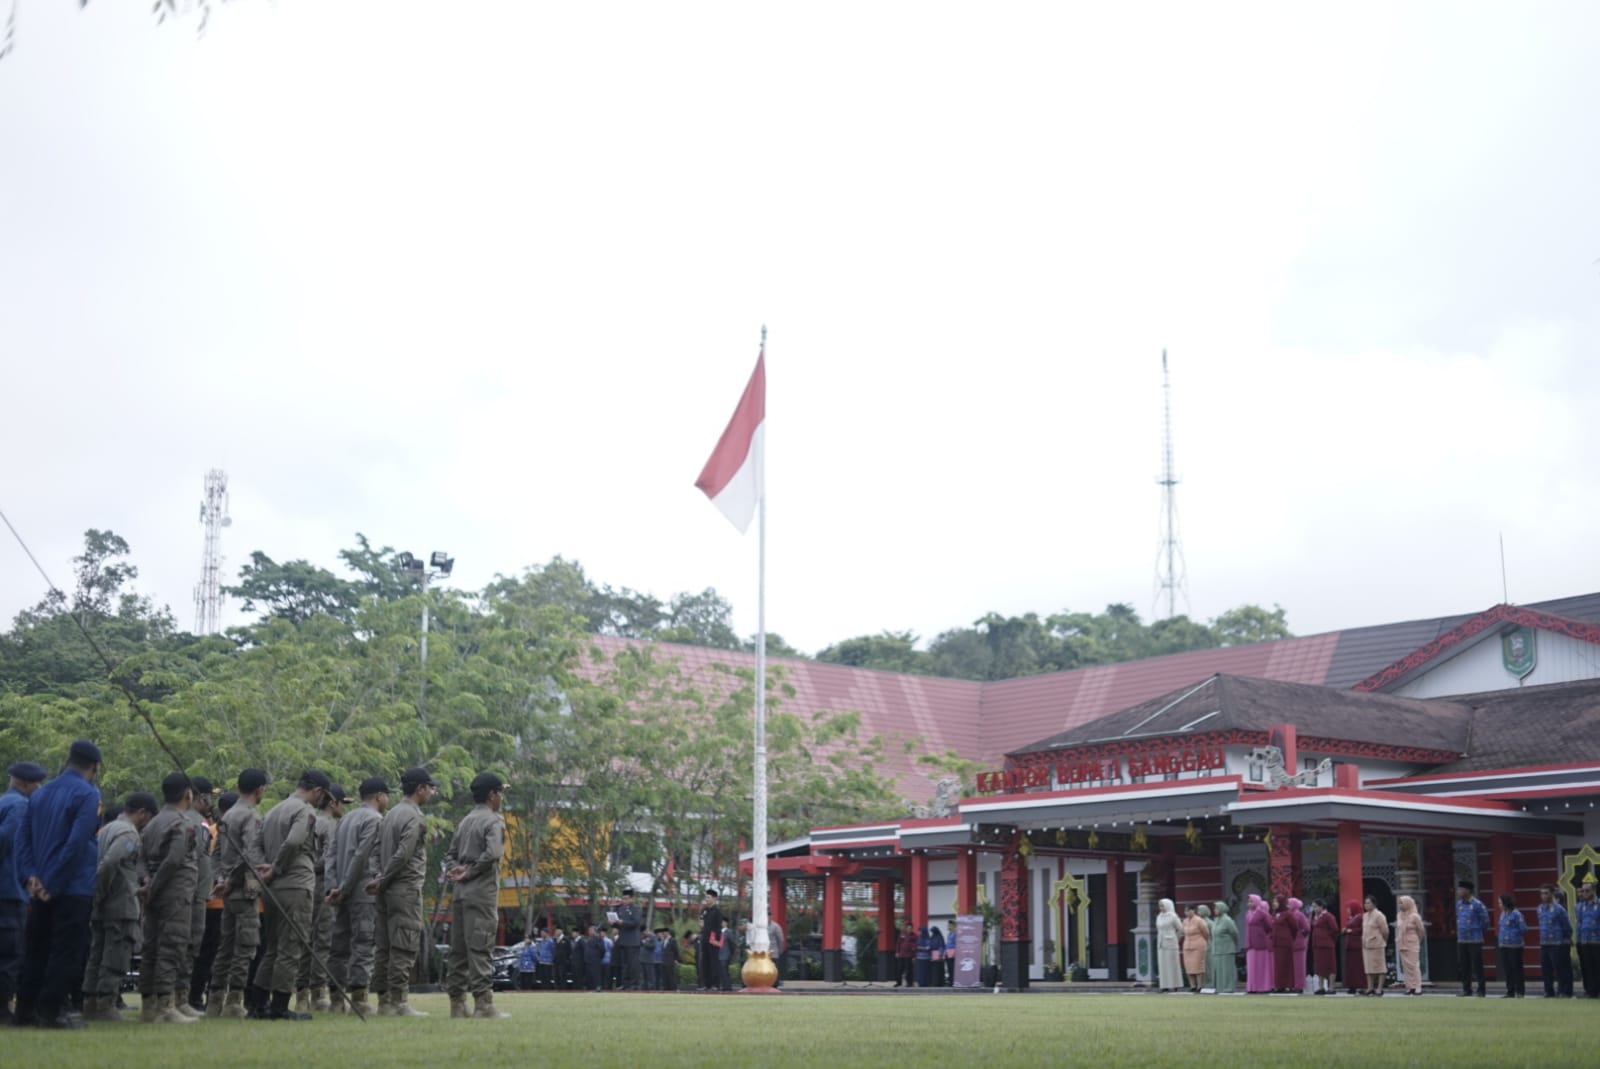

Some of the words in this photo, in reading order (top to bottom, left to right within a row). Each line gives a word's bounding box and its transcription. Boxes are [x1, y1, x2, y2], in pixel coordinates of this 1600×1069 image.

[976, 767, 1049, 792] KANTOR
[1056, 760, 1121, 784] BUPATI
[1128, 748, 1225, 776] SANGGAU
